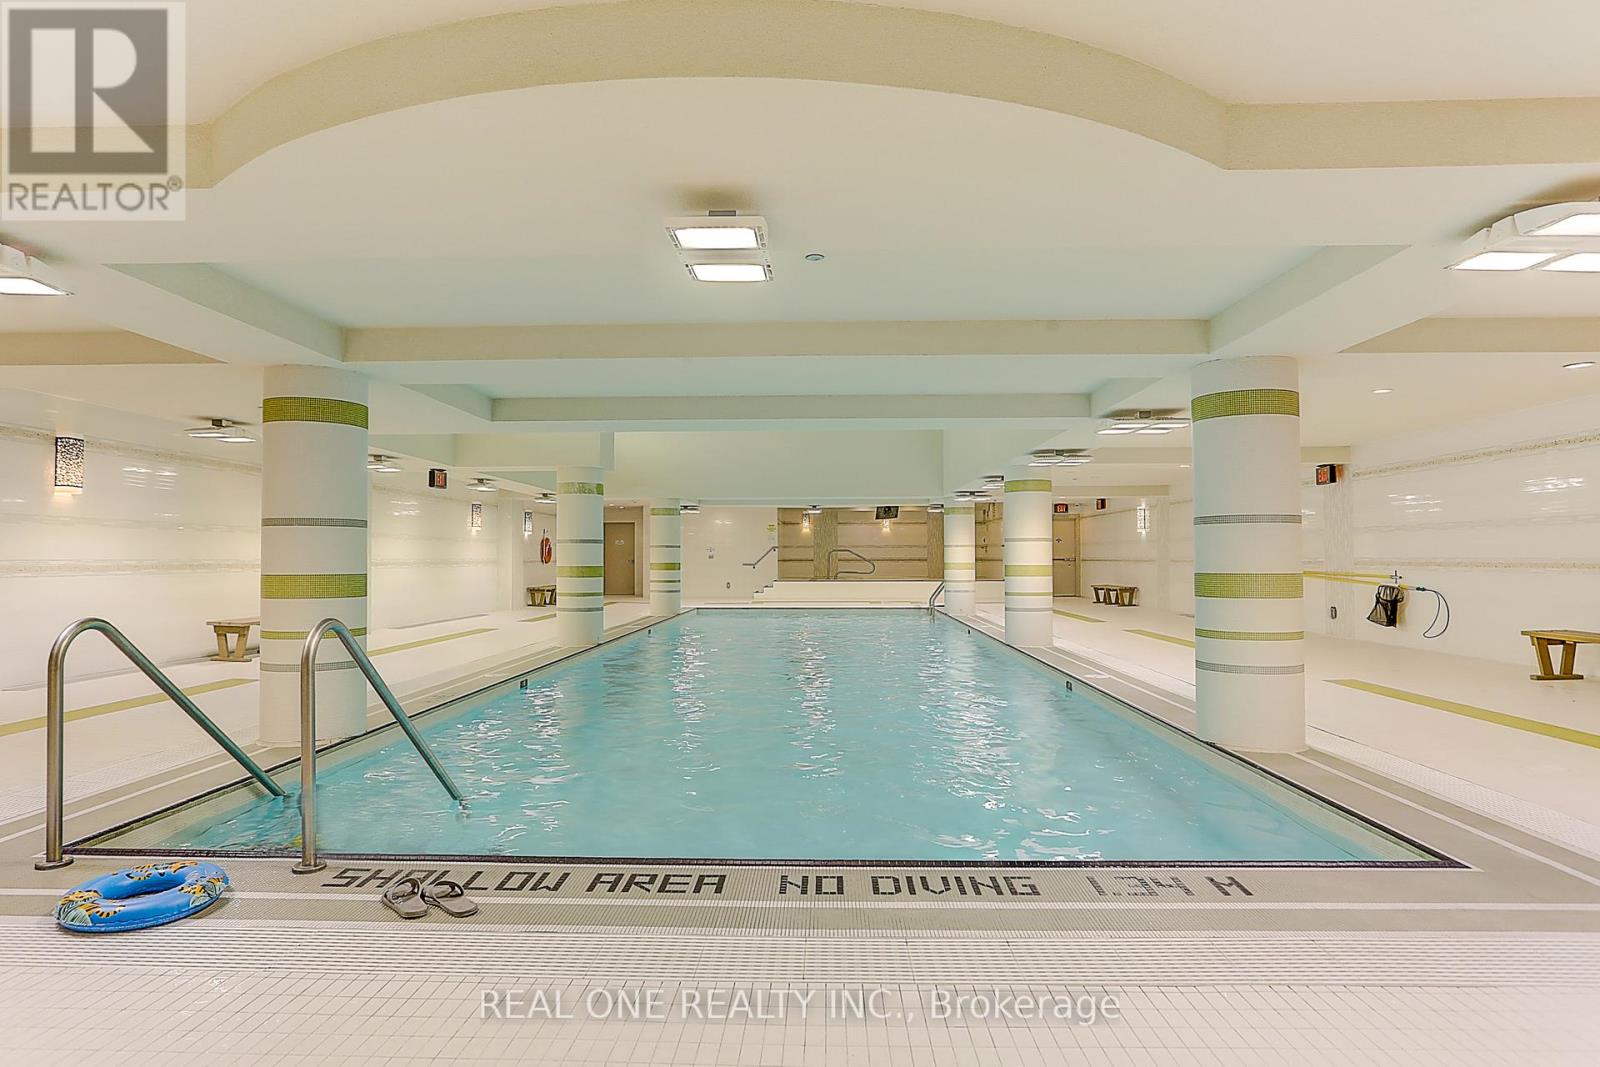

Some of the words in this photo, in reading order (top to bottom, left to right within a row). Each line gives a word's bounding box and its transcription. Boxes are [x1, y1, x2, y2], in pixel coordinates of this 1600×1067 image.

[585, 873, 727, 894] AREA
[779, 874, 844, 896] NO
[870, 875, 1041, 896] DIVING
[1086, 875, 1195, 897] 1.34
[1204, 875, 1253, 897] M
